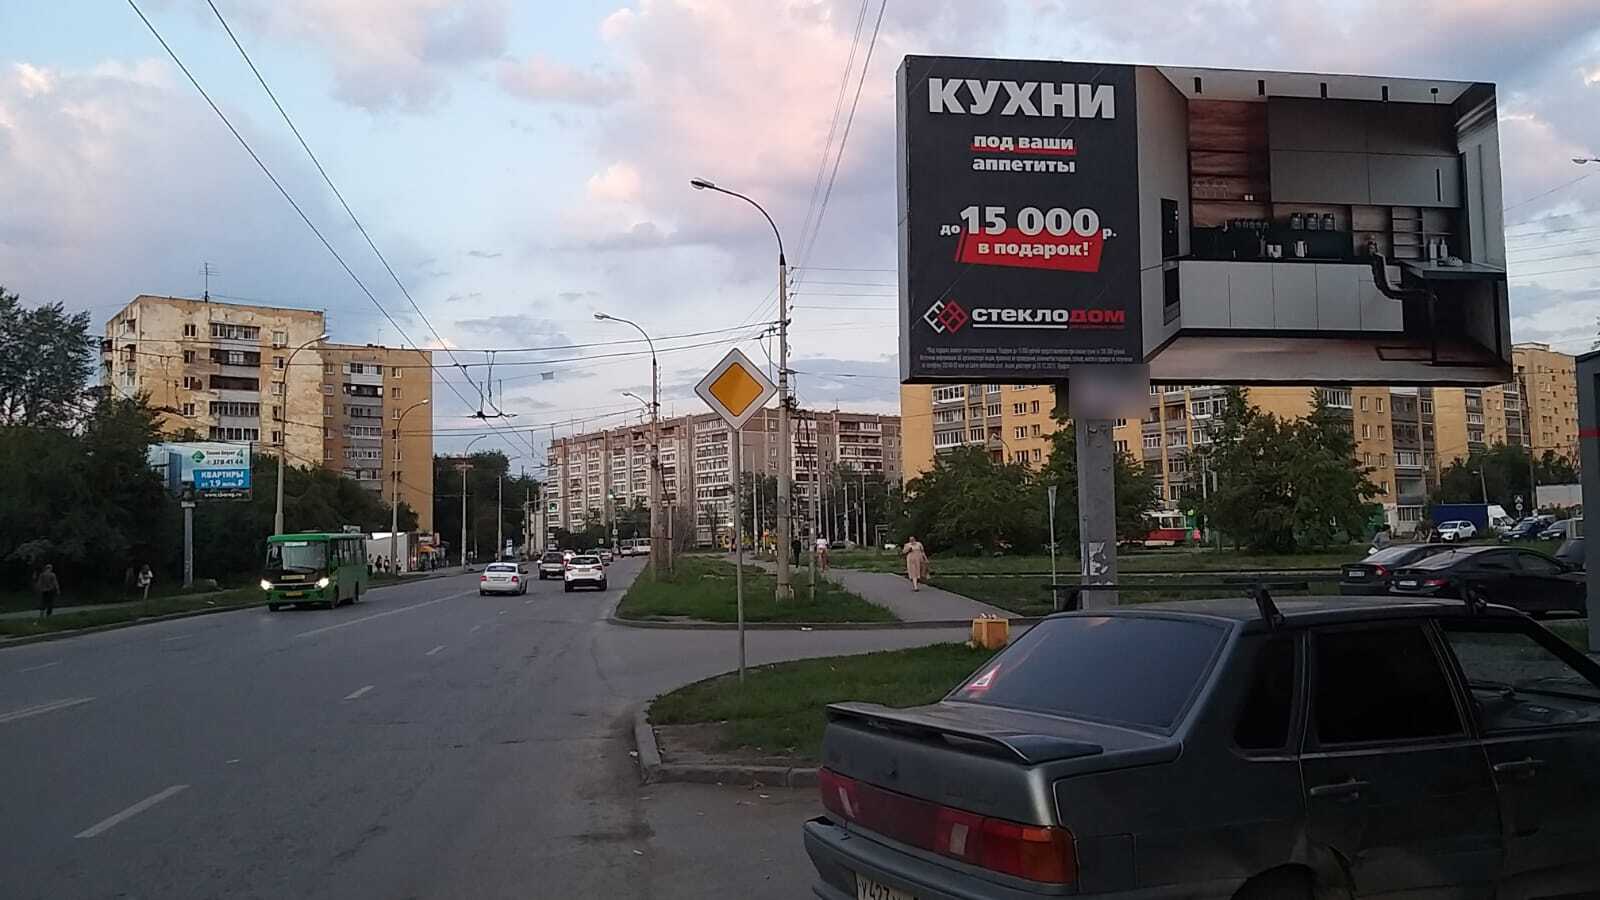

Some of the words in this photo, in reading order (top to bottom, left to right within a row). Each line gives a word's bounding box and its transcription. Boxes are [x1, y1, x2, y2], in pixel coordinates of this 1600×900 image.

[928, 77, 1116, 119] КУХНИ
[973, 135, 1014, 151] под
[1017, 136, 1075, 151] ваши
[972, 157, 1076, 173] аппетиты
[940, 224, 960, 236] до
[959, 206, 1007, 236] 15
[1017, 207, 1100, 237] 000
[1102, 227, 1117, 240] р.
[978, 242, 990, 255] в
[201, 471, 244, 479] КВАРТИРЫ
